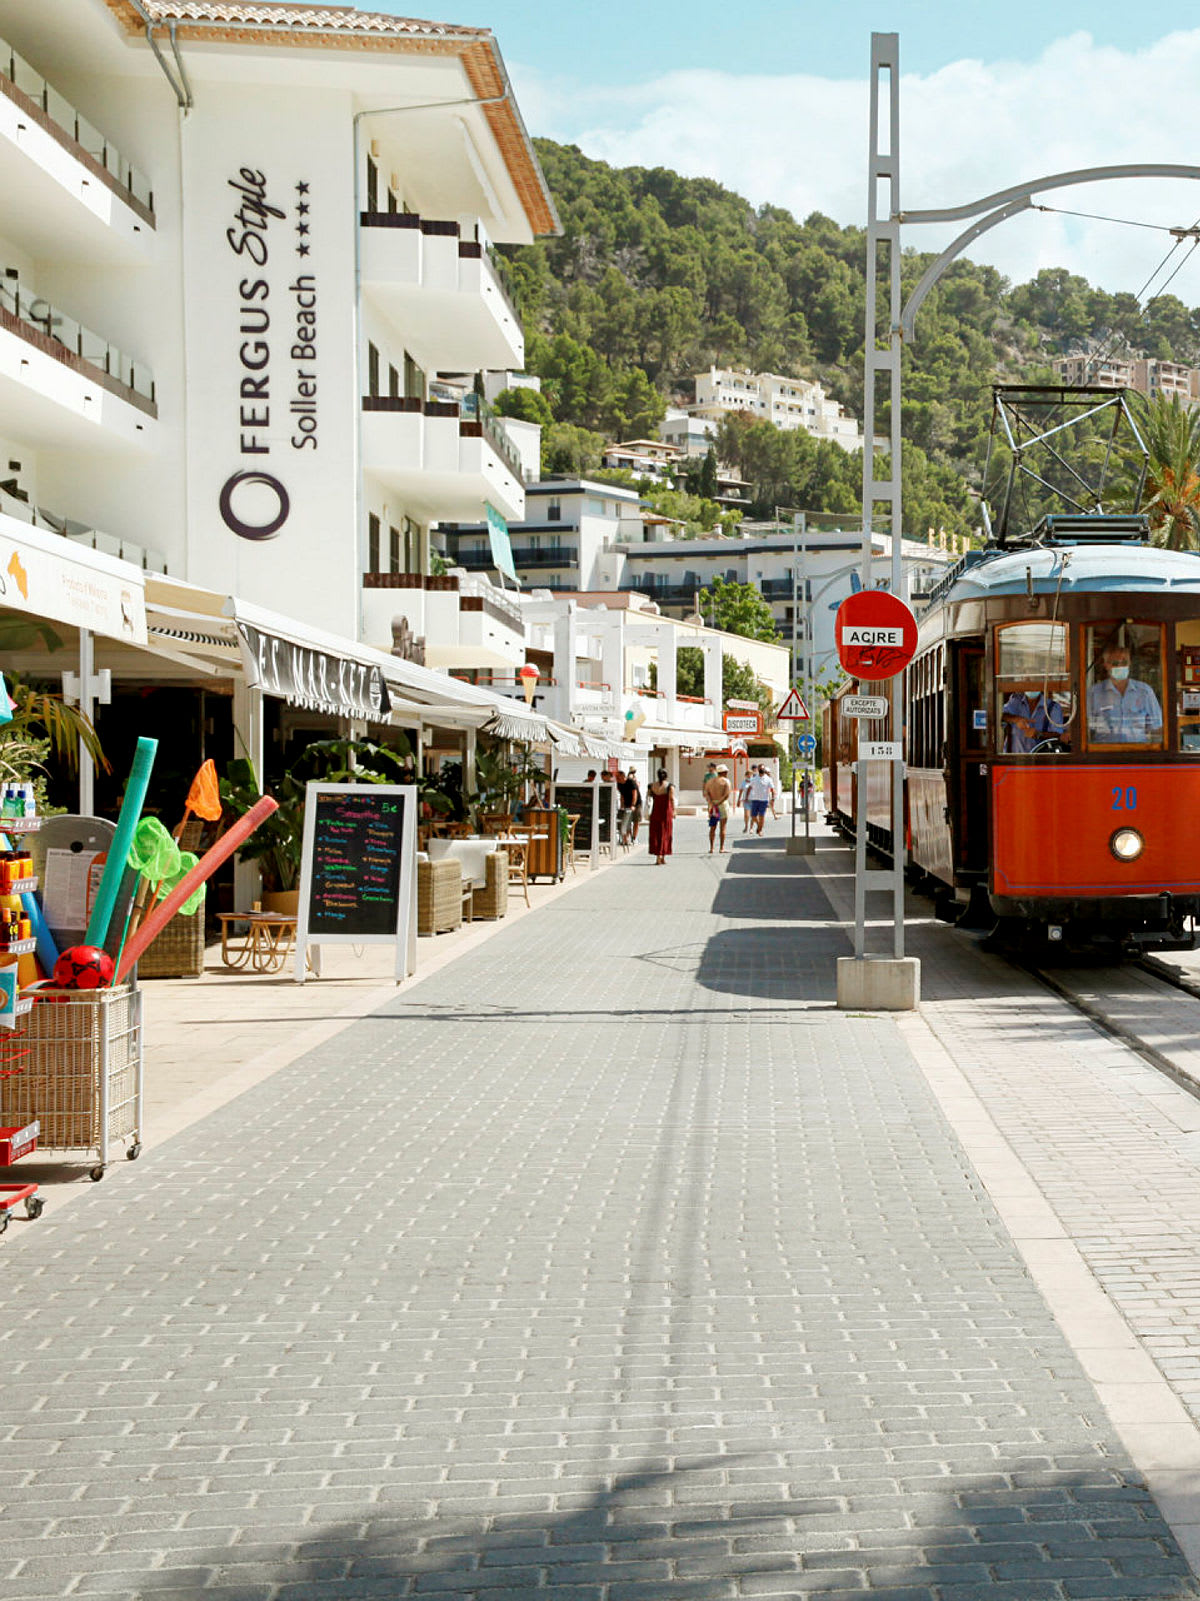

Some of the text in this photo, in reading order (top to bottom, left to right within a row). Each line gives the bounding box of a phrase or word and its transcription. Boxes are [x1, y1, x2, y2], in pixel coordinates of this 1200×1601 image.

[226, 167, 286, 454] FERGUS Style
[289, 275, 317, 450] Soller Beach
[258, 633, 281, 692] ES
[850, 699, 878, 707] EXCEPTE
[727, 719, 756, 730] DISCOTECA
[871, 746, 893, 755] 158
[1111, 786, 1137, 810] 20
